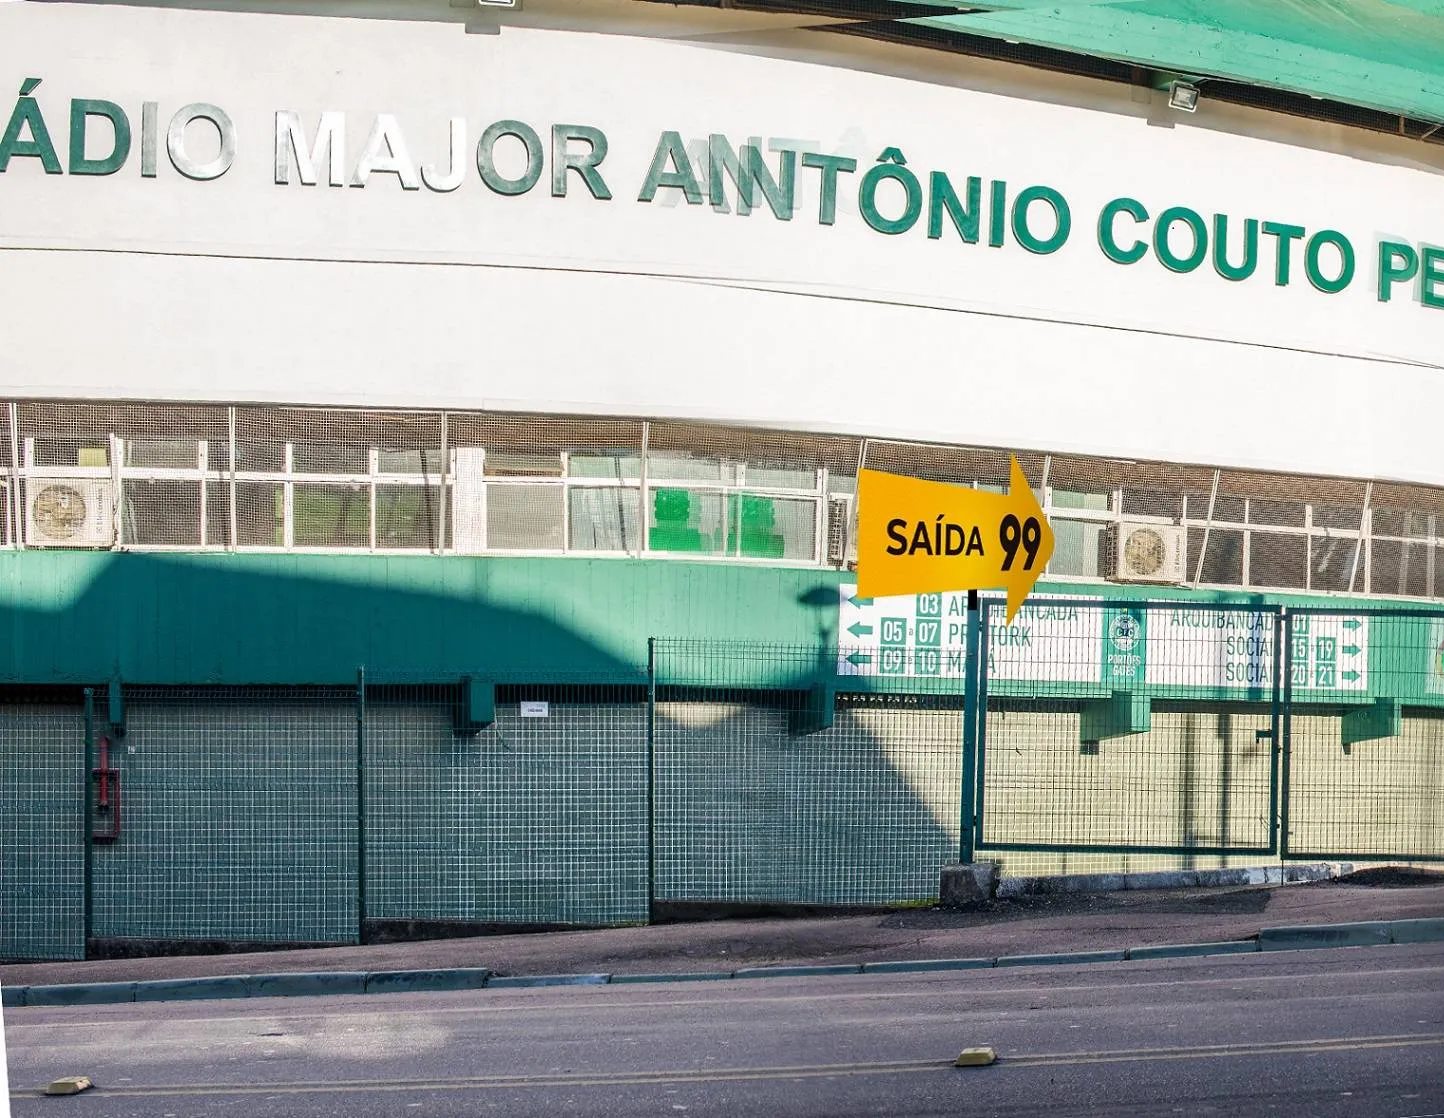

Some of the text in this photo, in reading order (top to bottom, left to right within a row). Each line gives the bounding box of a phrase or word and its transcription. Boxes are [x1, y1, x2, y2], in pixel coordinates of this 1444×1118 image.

[273, 109, 612, 200] MAJOR
[1097, 197, 1355, 294] COUTO
[886, 513, 1042, 571] SAÍDA 99
[919, 594, 938, 614] 03
[1170, 610, 1274, 631] ARQUIBANCAD
[883, 621, 902, 642] 05
[918, 622, 938, 643] 07
[1291, 639, 1306, 658] 15
[1318, 640, 1334, 659] 19
[883, 649, 900, 671] 09
[919, 650, 936, 672] 10
[1291, 664, 1306, 684] 20
[1319, 665, 1333, 684] 21
